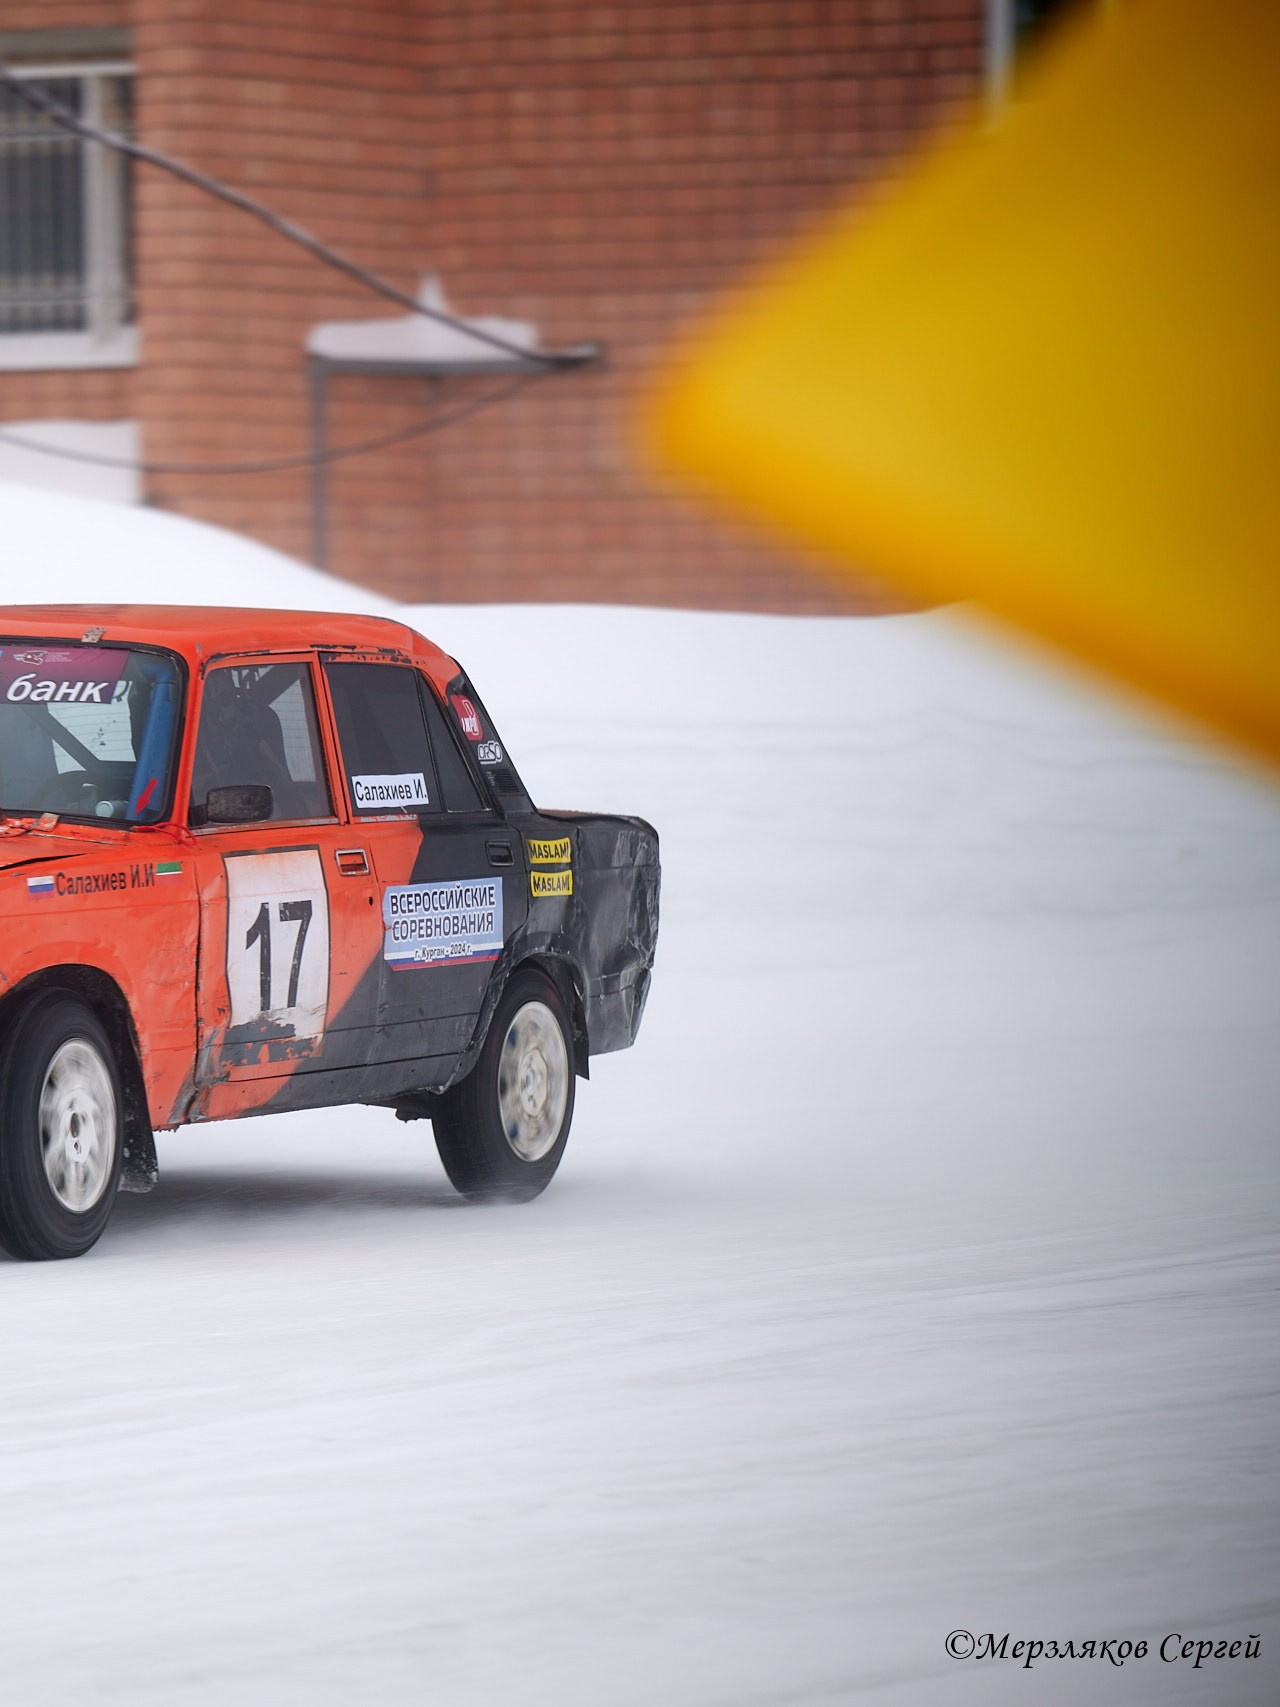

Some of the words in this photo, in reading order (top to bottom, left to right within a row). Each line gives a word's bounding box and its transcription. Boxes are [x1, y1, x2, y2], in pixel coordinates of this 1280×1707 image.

[6, 673, 108, 702] банк
[355, 781, 413, 801] Салахиев
[413, 779, 427, 799] И.
[56, 872, 127, 896] Салахиев
[130, 863, 155, 888] И.И
[390, 885, 496, 914] ВСЕРОССИЙСКИЕ
[392, 912, 494, 941] СОРЕВНОВАНИЯ
[246, 899, 312, 1011] 17
[422, 946, 445, 960] Курган
[450, 943, 466, 955] 2024
